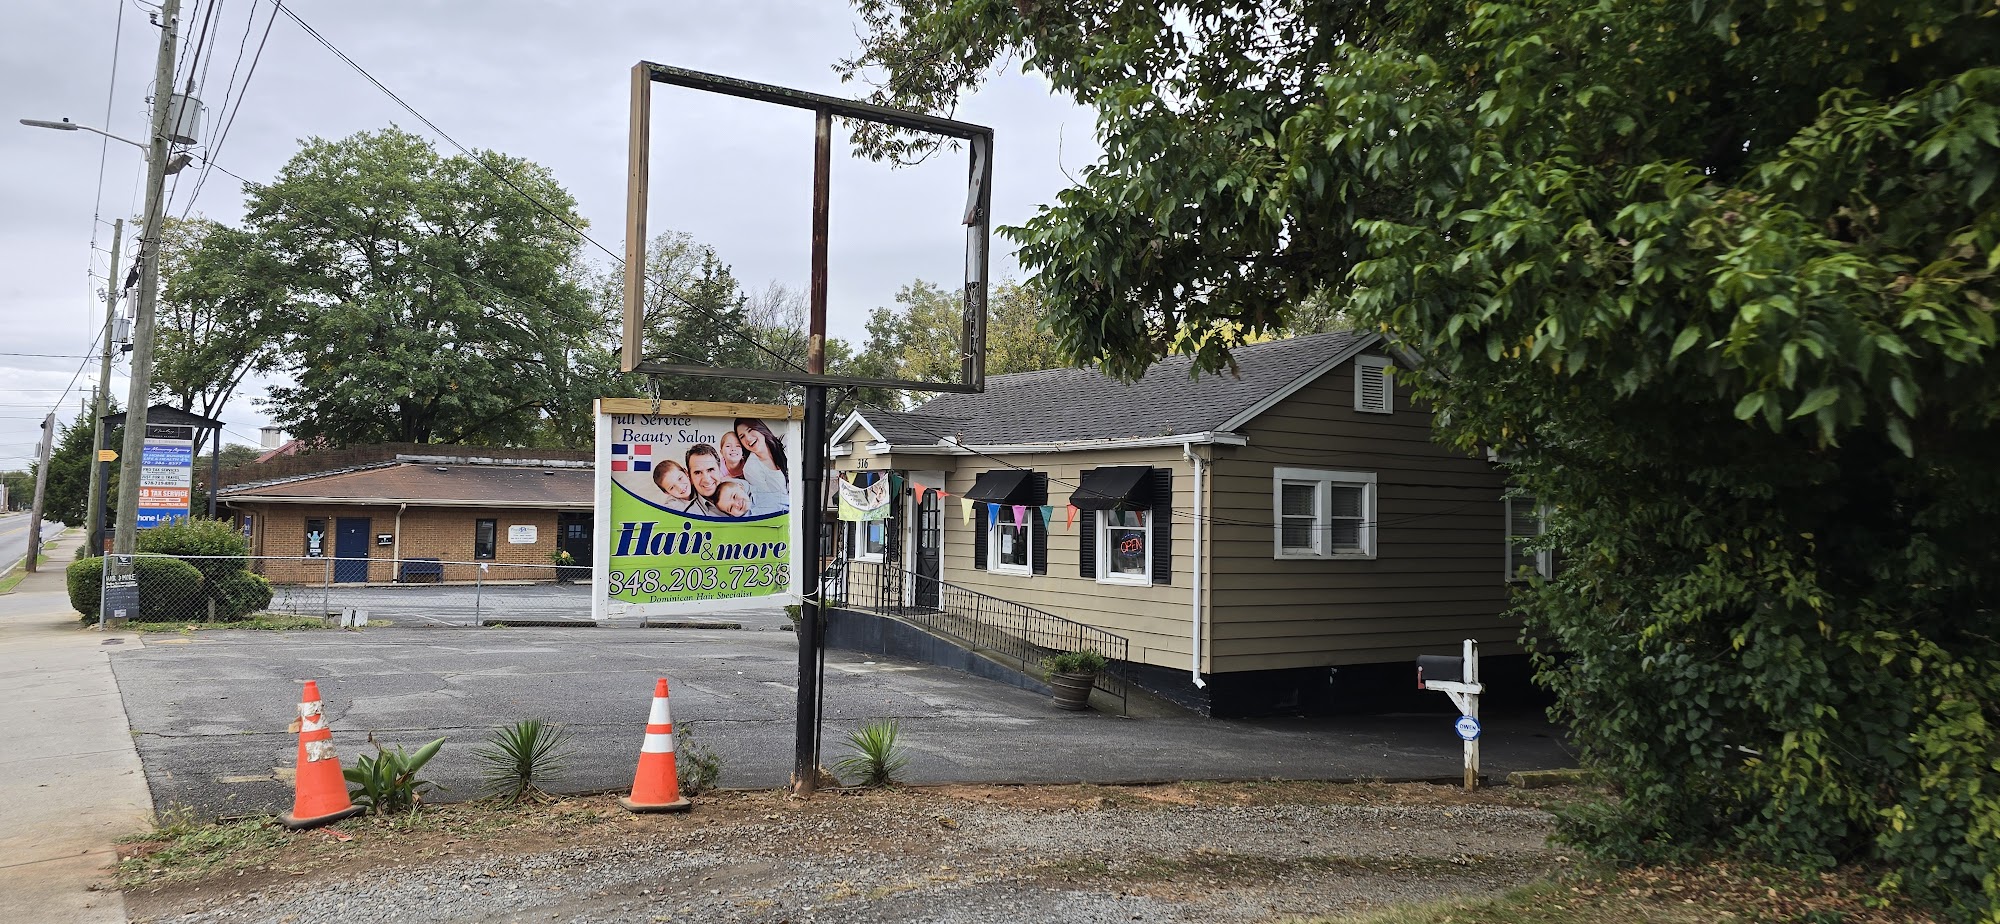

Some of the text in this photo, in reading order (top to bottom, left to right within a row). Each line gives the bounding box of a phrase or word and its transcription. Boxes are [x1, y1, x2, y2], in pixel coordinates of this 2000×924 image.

[611, 413, 692, 426] ull Service
[622, 428, 716, 446] Beauty Salon
[857, 458, 869, 469] 316
[150, 490, 162, 498] TAX
[163, 490, 189, 498] SERVICE
[137, 514, 156, 522] hone
[611, 521, 787, 561] Hair & more
[1120, 538, 1143, 553] OPEN
[608, 563, 791, 597] 848.203.7238
[650, 589, 753, 604] Dominican Hair Specialist
